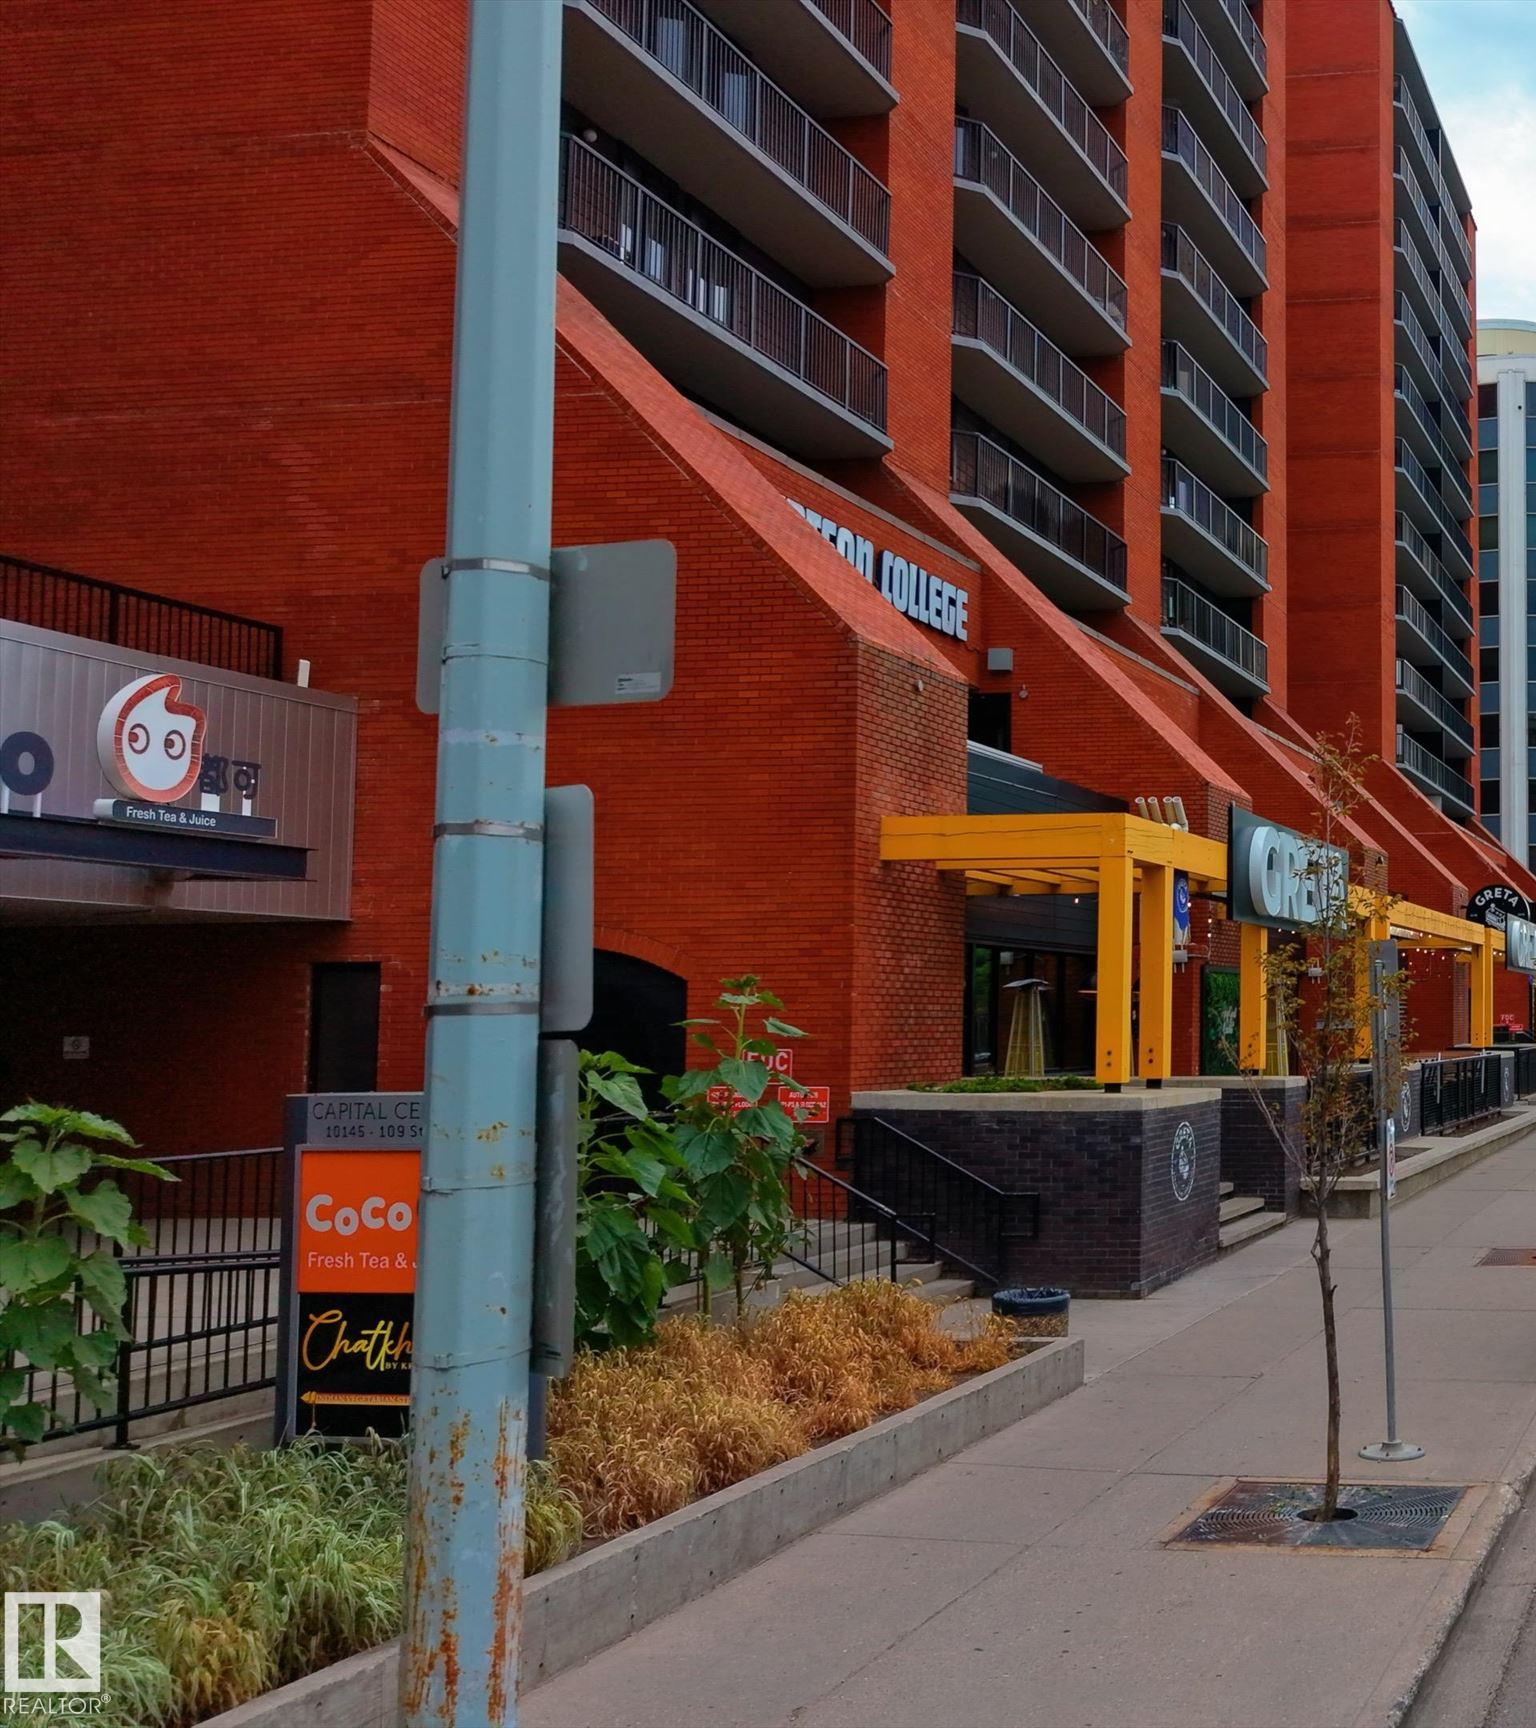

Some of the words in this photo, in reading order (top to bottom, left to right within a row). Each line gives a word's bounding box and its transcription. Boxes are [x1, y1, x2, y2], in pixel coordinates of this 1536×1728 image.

[881, 550, 968, 641] COLLEGE
[126, 806, 156, 820] Fresh
[158, 809, 177, 822] Tea
[179, 812, 187, 823] &
[188, 812, 216, 828] Juice
[1475, 887, 1519, 908] GRETA
[312, 1102, 387, 1120] CAPITAL
[326, 1125, 365, 1138] 10145
[380, 1125, 405, 1138] 109
[308, 1252, 354, 1268] Fresh
[359, 1252, 389, 1268] Tea
[395, 1253, 408, 1268] &
